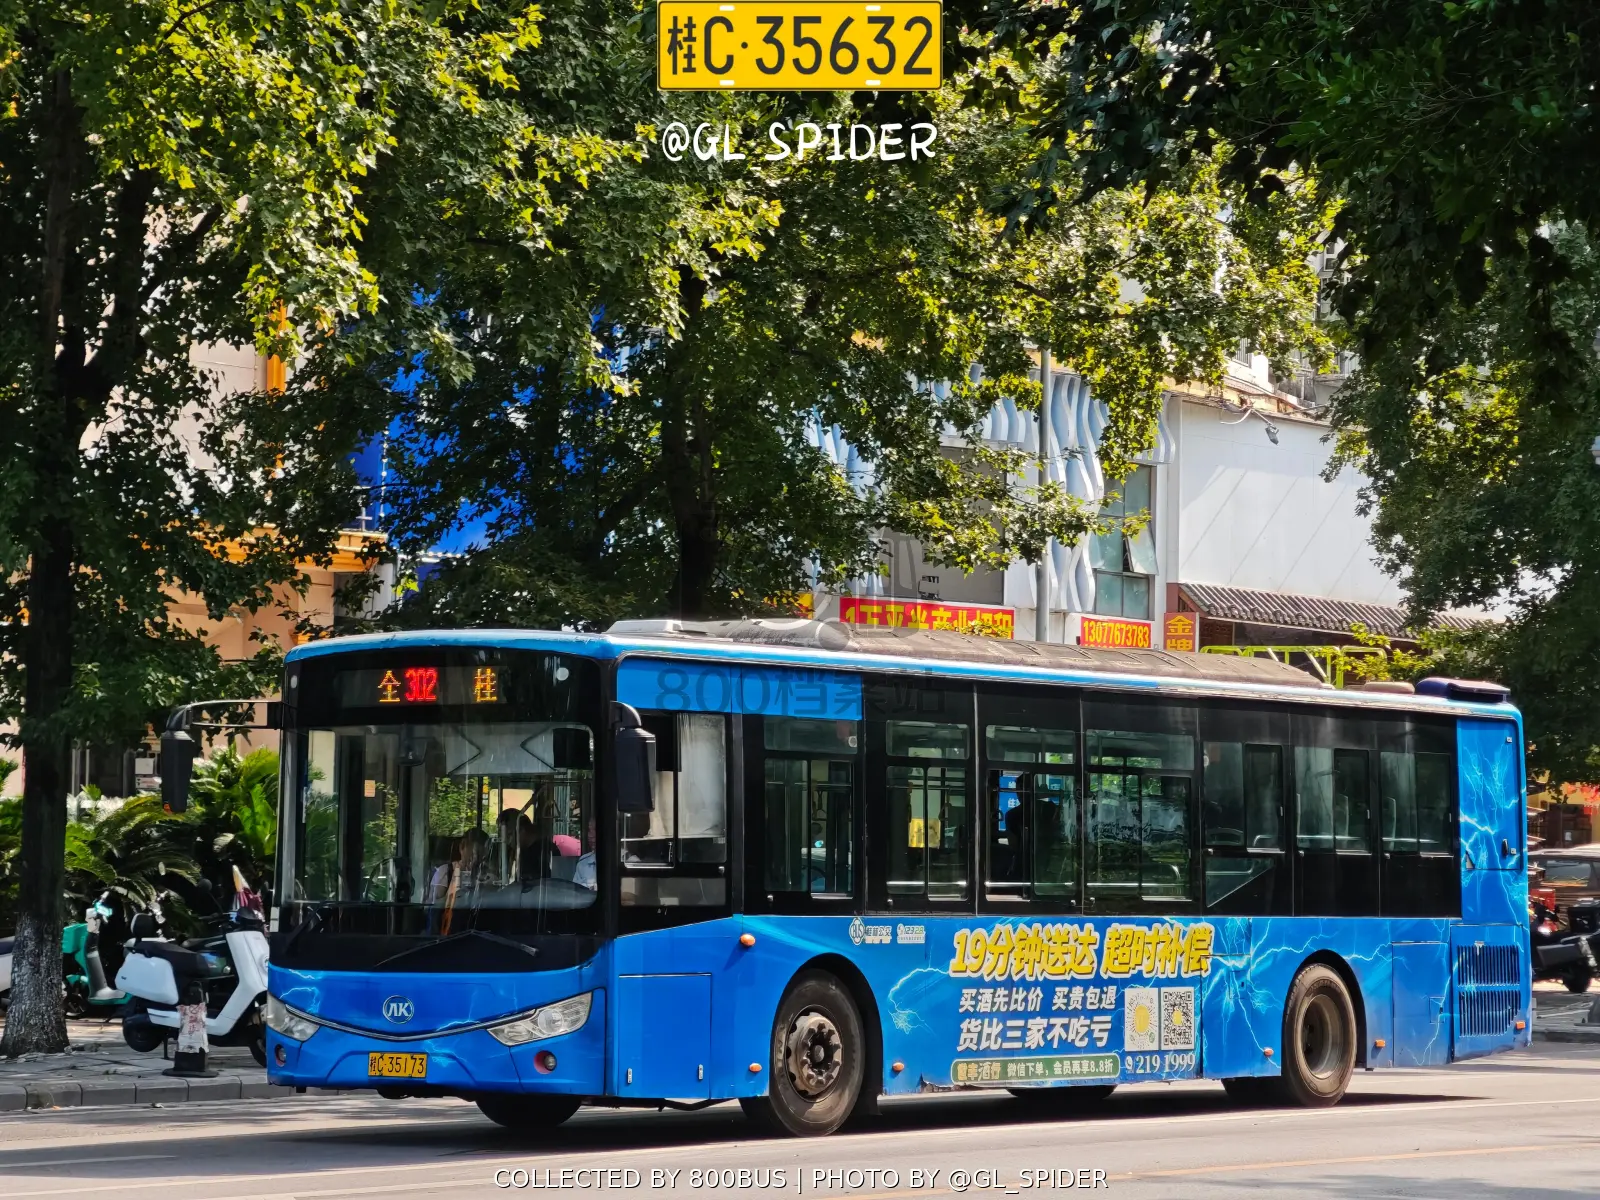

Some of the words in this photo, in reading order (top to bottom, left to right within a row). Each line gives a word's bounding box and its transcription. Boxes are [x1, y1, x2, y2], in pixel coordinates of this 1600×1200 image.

[1083, 620, 1149, 648] 13077673783
[404, 668, 438, 701] 302
[474, 668, 498, 702] 桂
[950, 925, 1098, 979] 19分钟送达
[1101, 925, 1213, 977] 超时补偿
[959, 987, 1044, 1012] 买酒先比价
[1052, 986, 1117, 1010] 买贵包退
[957, 1016, 1112, 1051] 货比三家不吃亏
[1136, 1055, 1160, 1074] 219
[1164, 1053, 1196, 1073] 1999
